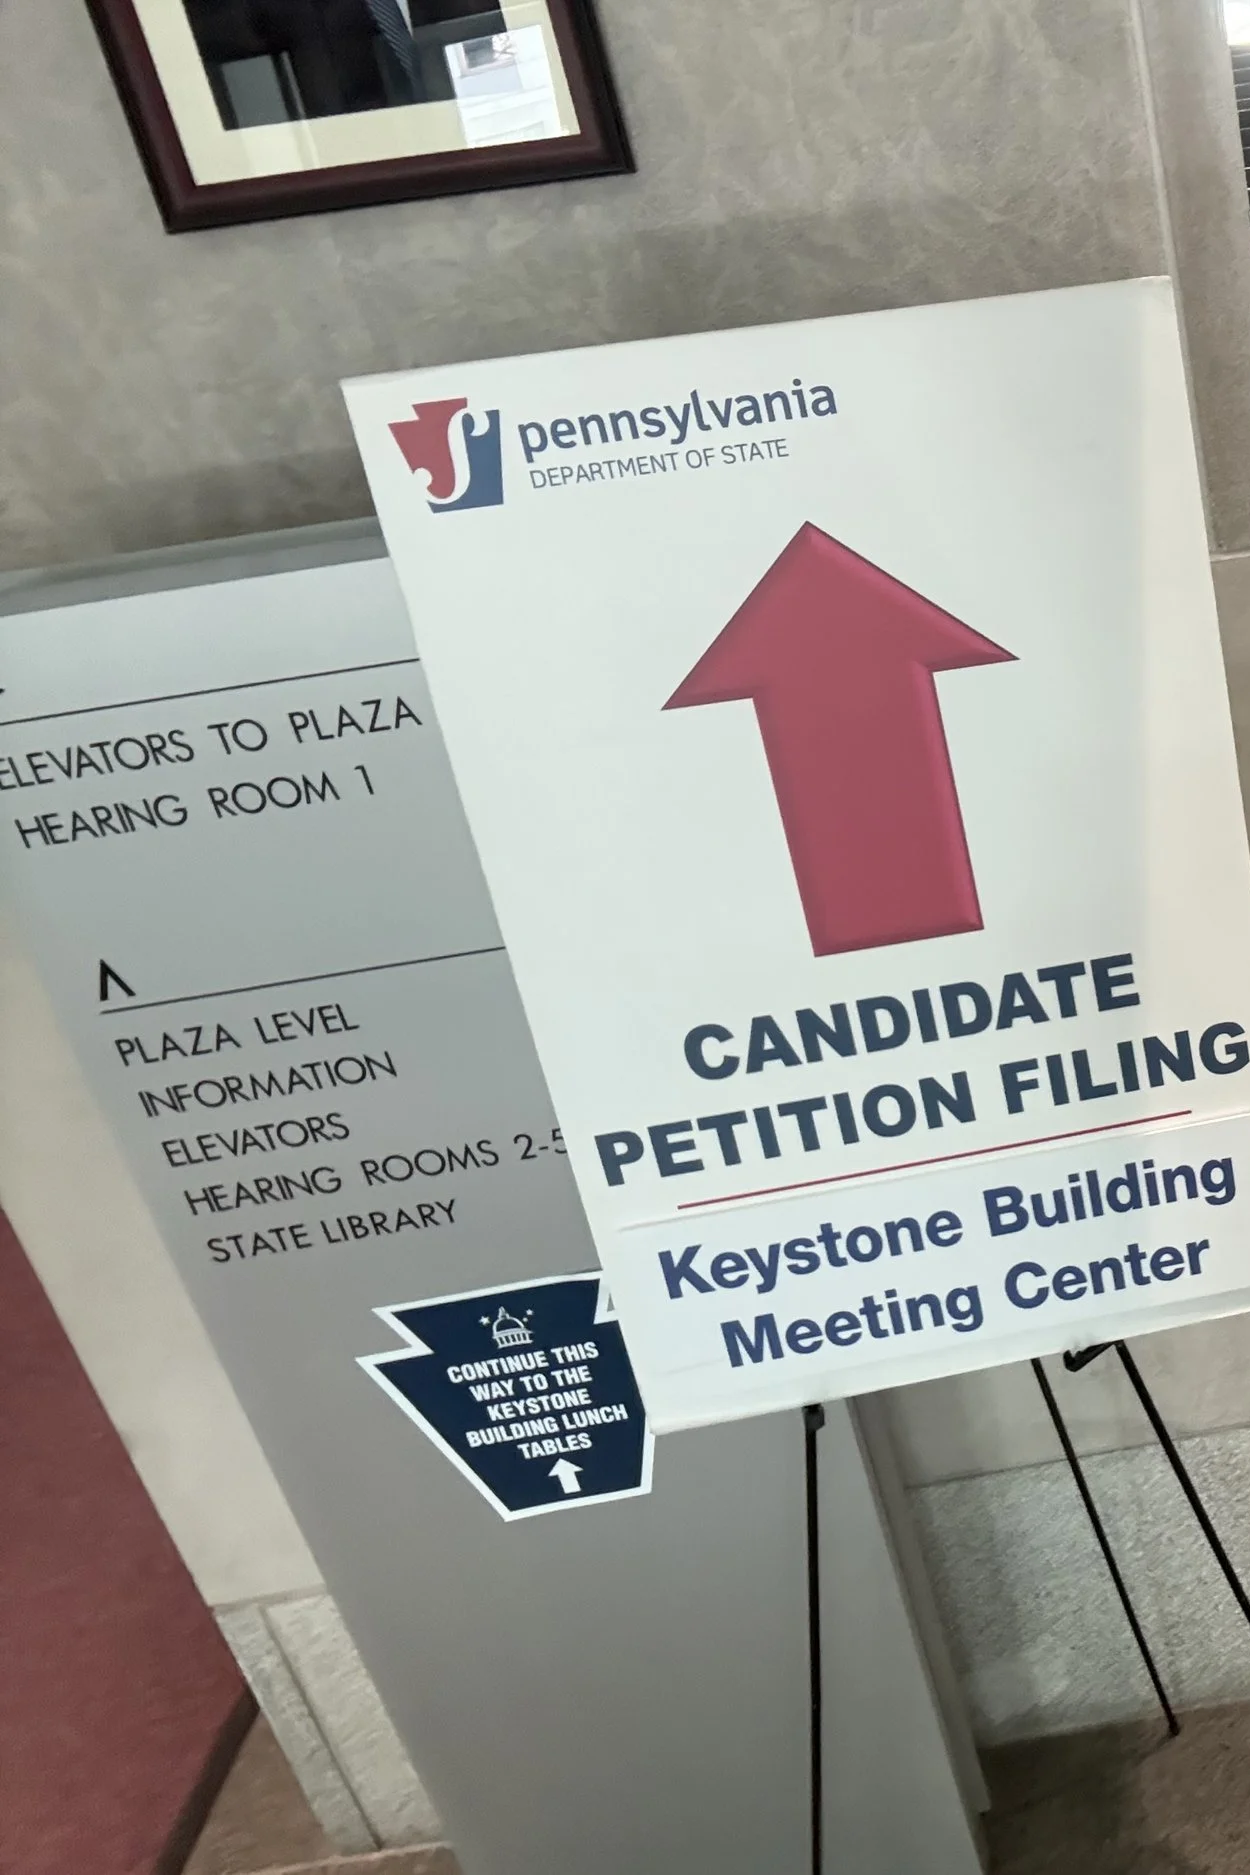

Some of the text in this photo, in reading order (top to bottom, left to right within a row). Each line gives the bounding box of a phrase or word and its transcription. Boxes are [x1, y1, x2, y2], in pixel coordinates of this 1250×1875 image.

[518, 378, 838, 463] pennsylvania
[529, 438, 790, 489] DEPARTMENT OF STATE
[0, 696, 422, 791] ELEVATORS TO PLAZA
[14, 764, 375, 849] HEARING ROOM 1
[114, 1003, 360, 1067] PLAZA LEVEL
[683, 952, 1141, 1081] CANDIDATE
[138, 1051, 398, 1117] INFORMATION
[594, 1021, 1250, 1187] PETITION FILING
[161, 1112, 350, 1168] ELEVATORS
[183, 1127, 568, 1216] HEARING ROOMS 2-5
[206, 1199, 456, 1263] STATE LIBRARY
[658, 1156, 1237, 1299] Keystone Building
[720, 1238, 1211, 1368] Meeting Center
[446, 1341, 599, 1384] CONTINUE THIS
[468, 1365, 593, 1402] WAY TO THE
[465, 1403, 629, 1448] BUILDING LUNCH
[487, 1388, 592, 1421] KEYSTONE
[517, 1432, 593, 1460] TABLES
